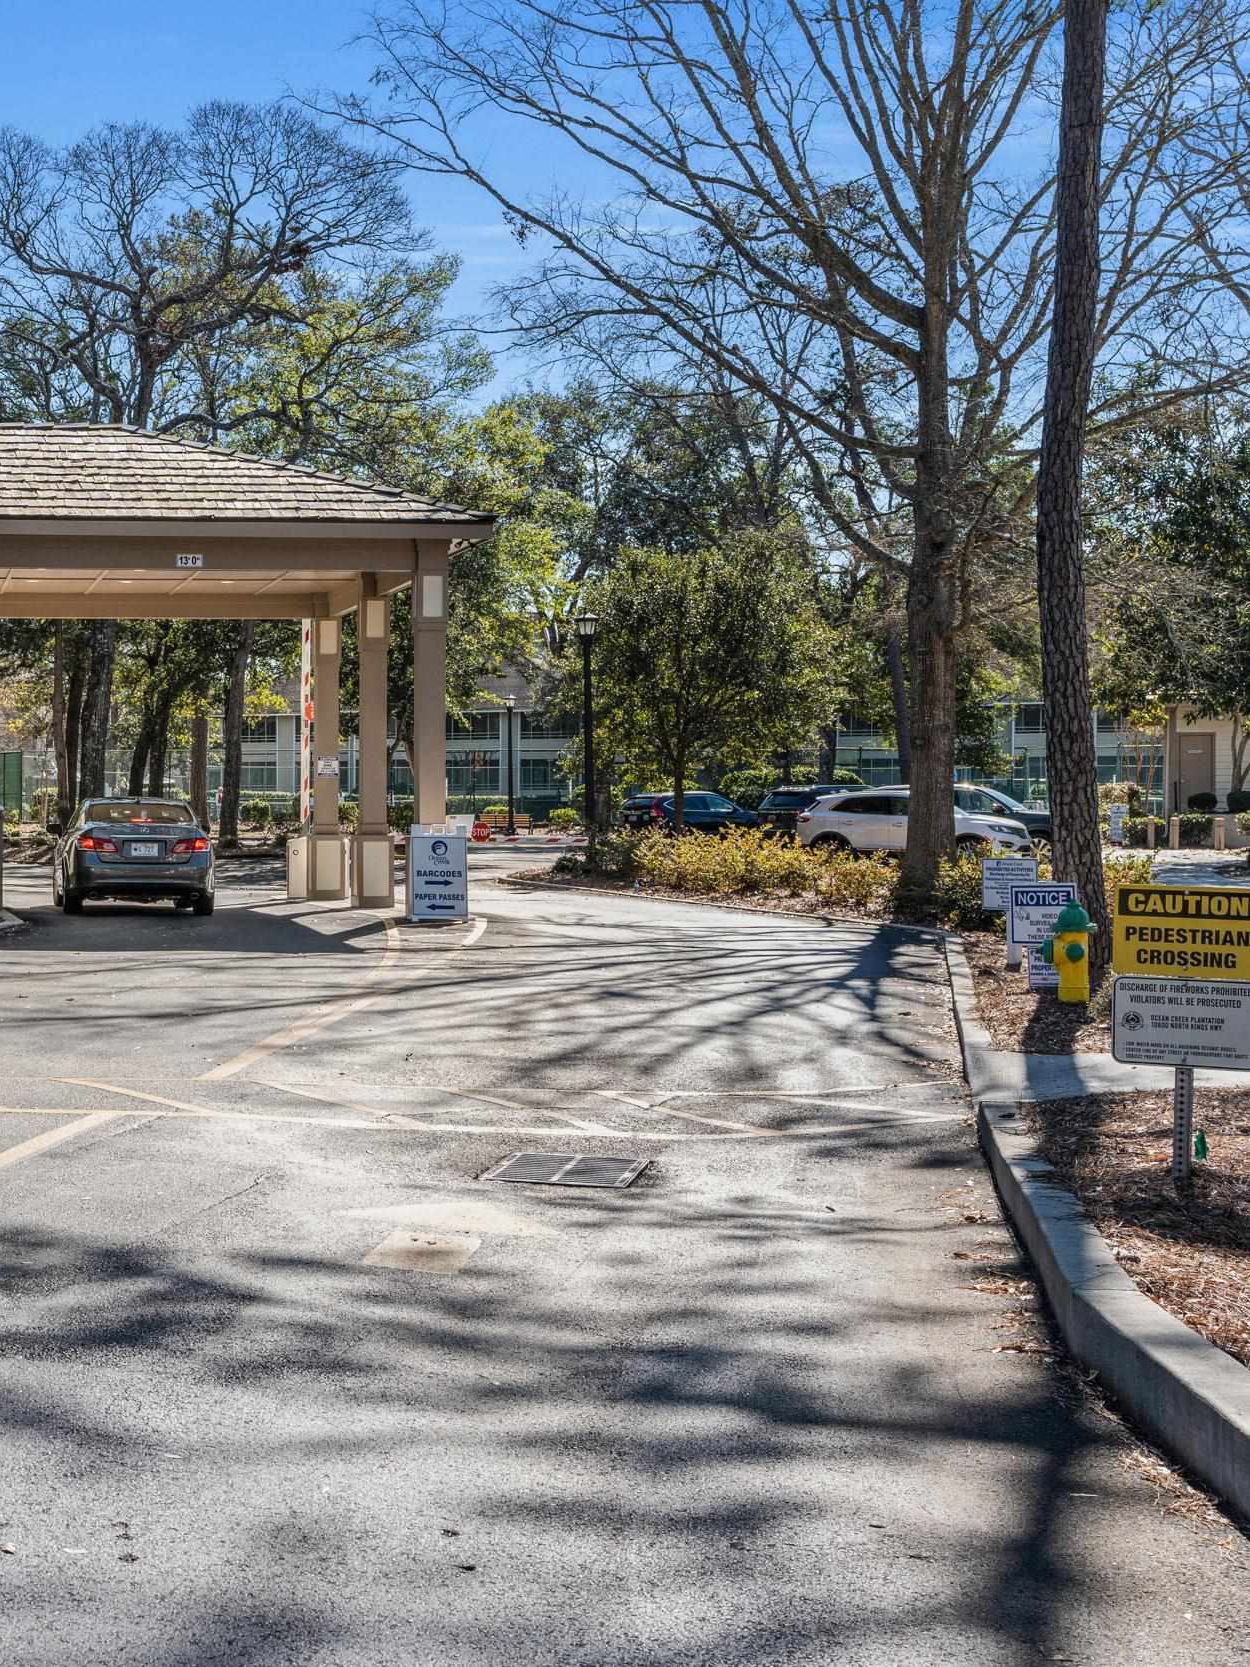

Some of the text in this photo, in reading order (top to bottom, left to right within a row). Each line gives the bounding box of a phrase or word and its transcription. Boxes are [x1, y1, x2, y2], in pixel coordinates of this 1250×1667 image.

[472, 829, 491, 837] STOP
[416, 870, 463, 878] BARCODES
[414, 893, 465, 902] PAPER PASSES
[1017, 892, 1068, 905] NOTICE
[1127, 892, 1250, 917] CAUTION
[1041, 912, 1058, 920] VIDEO
[1125, 926, 1250, 947] PEDESTRIAN
[1136, 948, 1237, 969] CROSSING
[1119, 982, 1250, 997] DISCHARGE OF FIREWORKS PROHIBITE
[1129, 994, 1242, 1009] VIOLATORS WILL BE PROSECUTED
[1150, 1014, 1225, 1025] OCEAN CREEK PLANTATION
[1170, 1022, 1189, 1030] NORTH
[1190, 1023, 1208, 1031] KINGS
